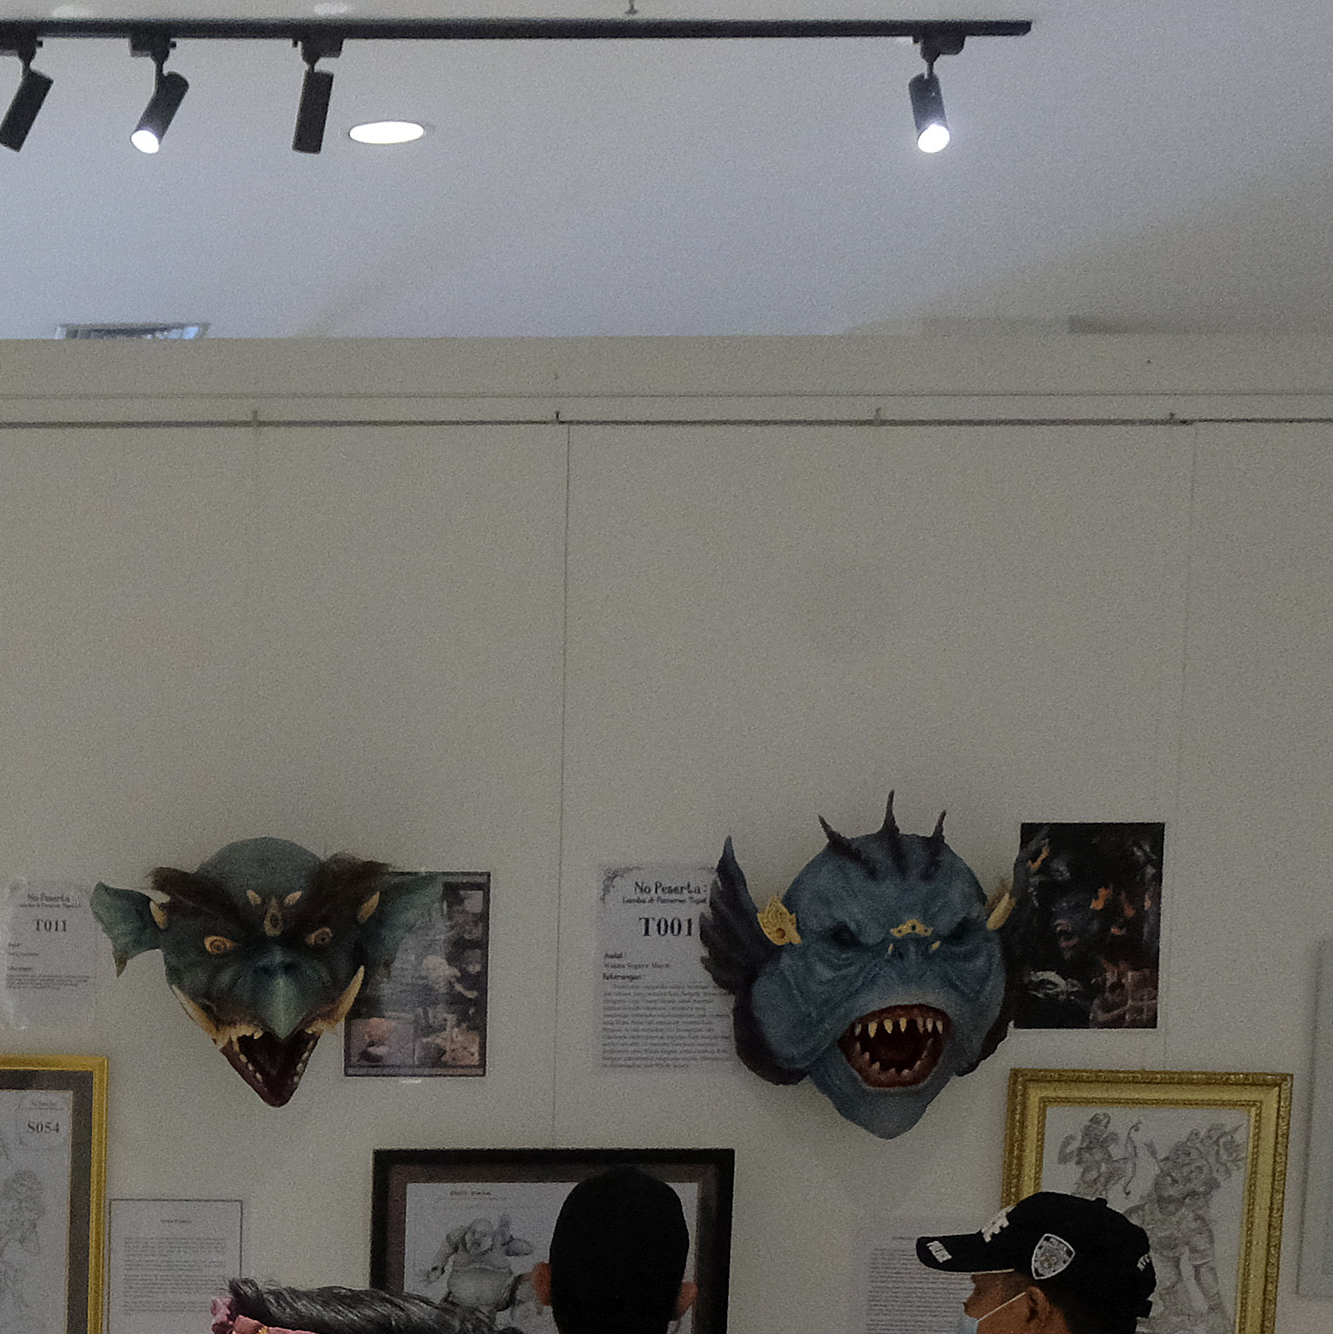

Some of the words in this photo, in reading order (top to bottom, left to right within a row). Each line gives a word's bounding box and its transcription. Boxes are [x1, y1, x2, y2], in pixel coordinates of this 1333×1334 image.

[634, 881, 651, 895] No
[33, 919, 67, 932] T011
[639, 917, 694, 937] T001
[27, 1120, 60, 1134] S054
